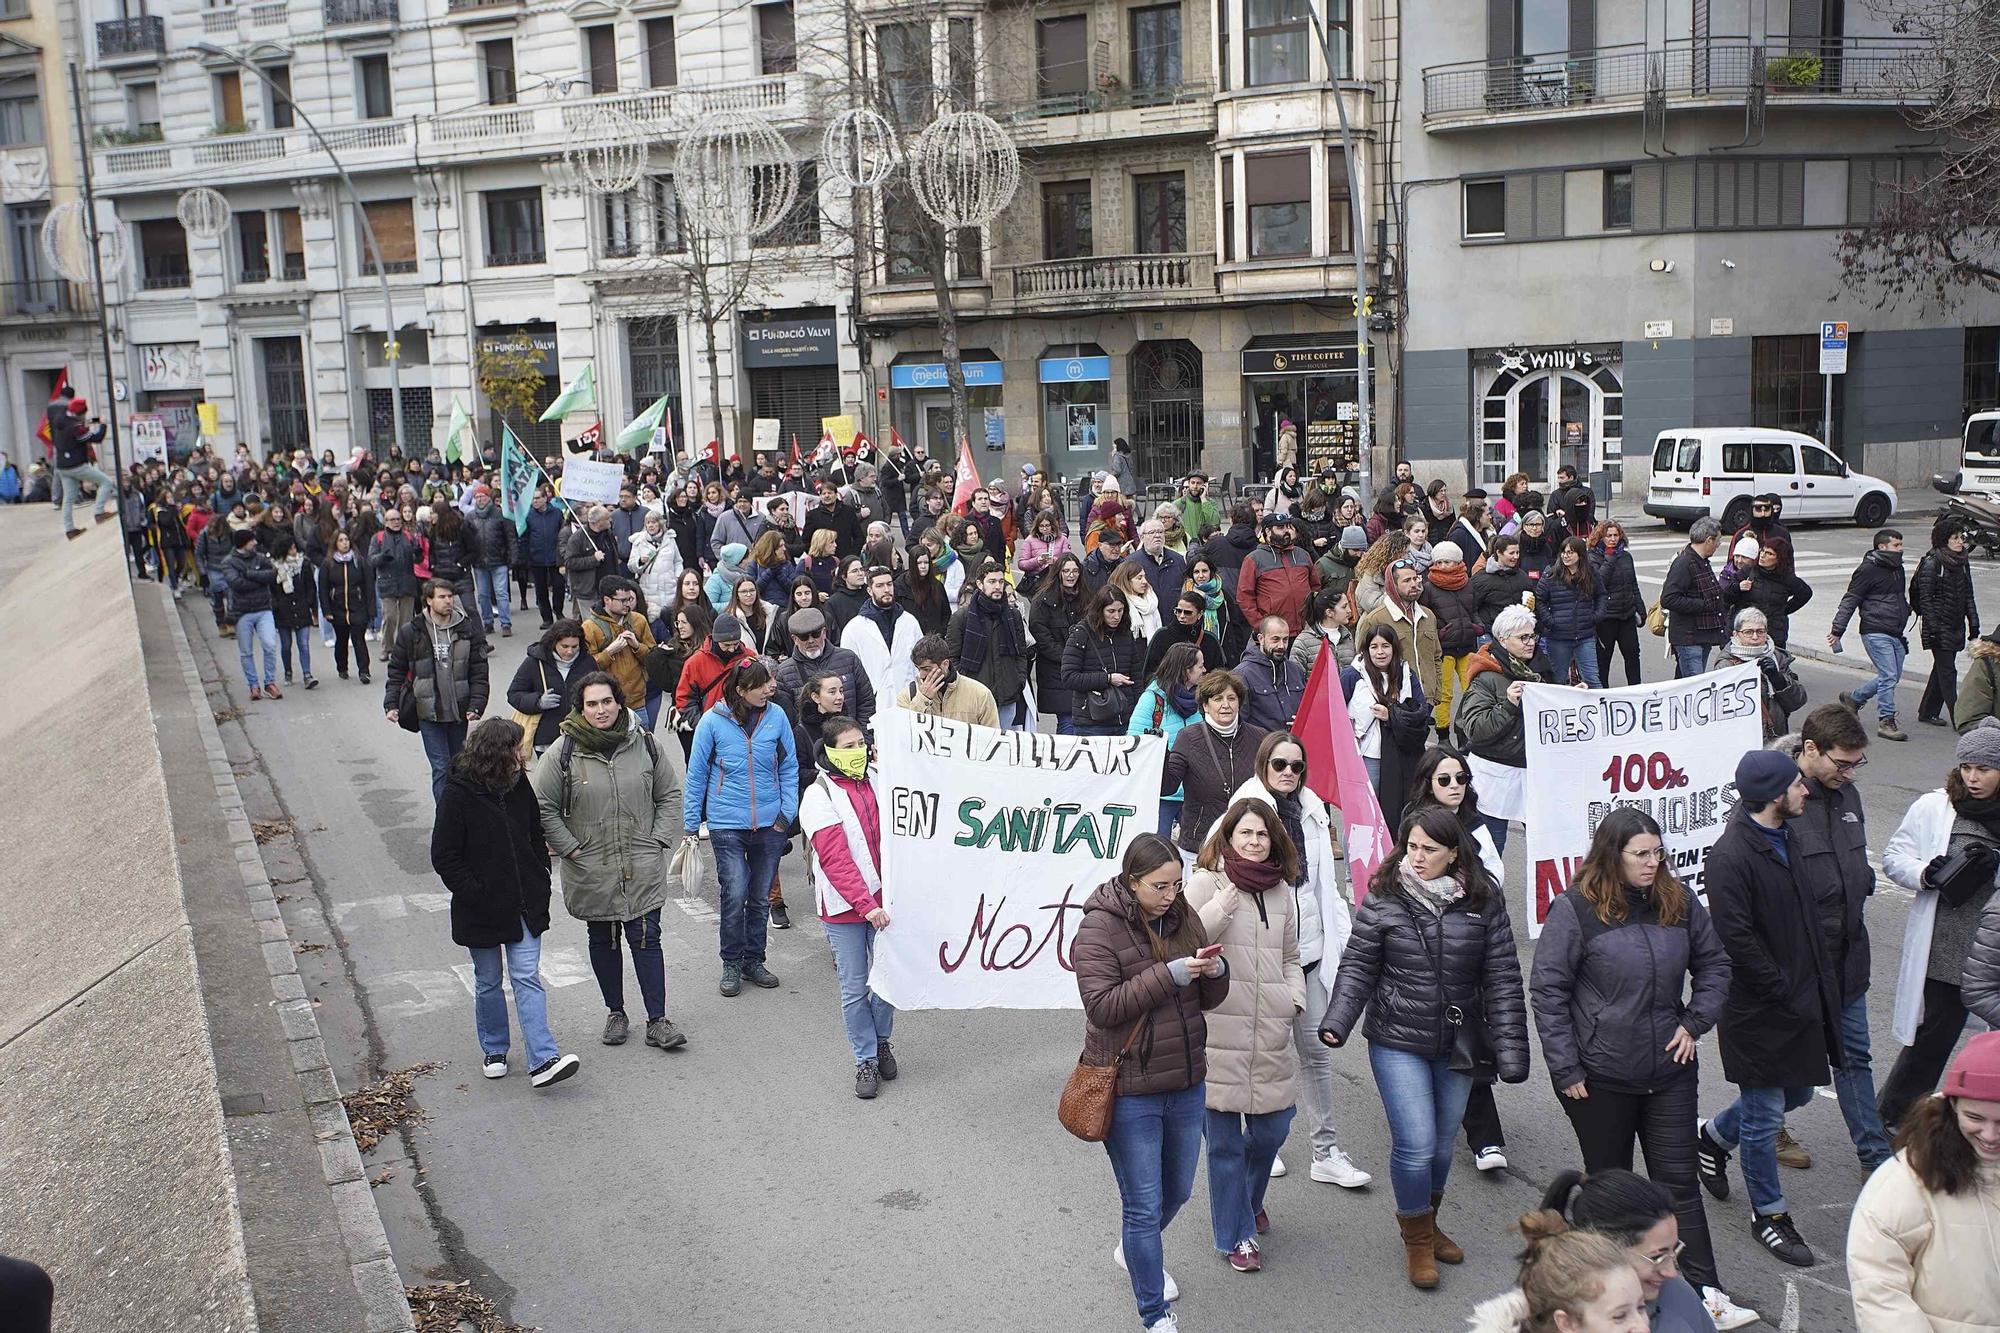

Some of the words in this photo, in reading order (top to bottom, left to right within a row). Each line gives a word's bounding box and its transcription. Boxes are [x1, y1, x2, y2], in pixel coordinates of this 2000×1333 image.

[534, 339, 556, 350] VALVI
[762, 326, 805, 340] FUNDACIÓ
[806, 326, 831, 337] VALVI
[1825, 325, 1833, 338] P
[1314, 352, 1345, 360] COFFEE
[911, 713, 1140, 776] RETALLAR
[1602, 751, 1689, 794] 100%
[892, 787, 939, 840] EN
[939, 884, 1083, 974] Mat
